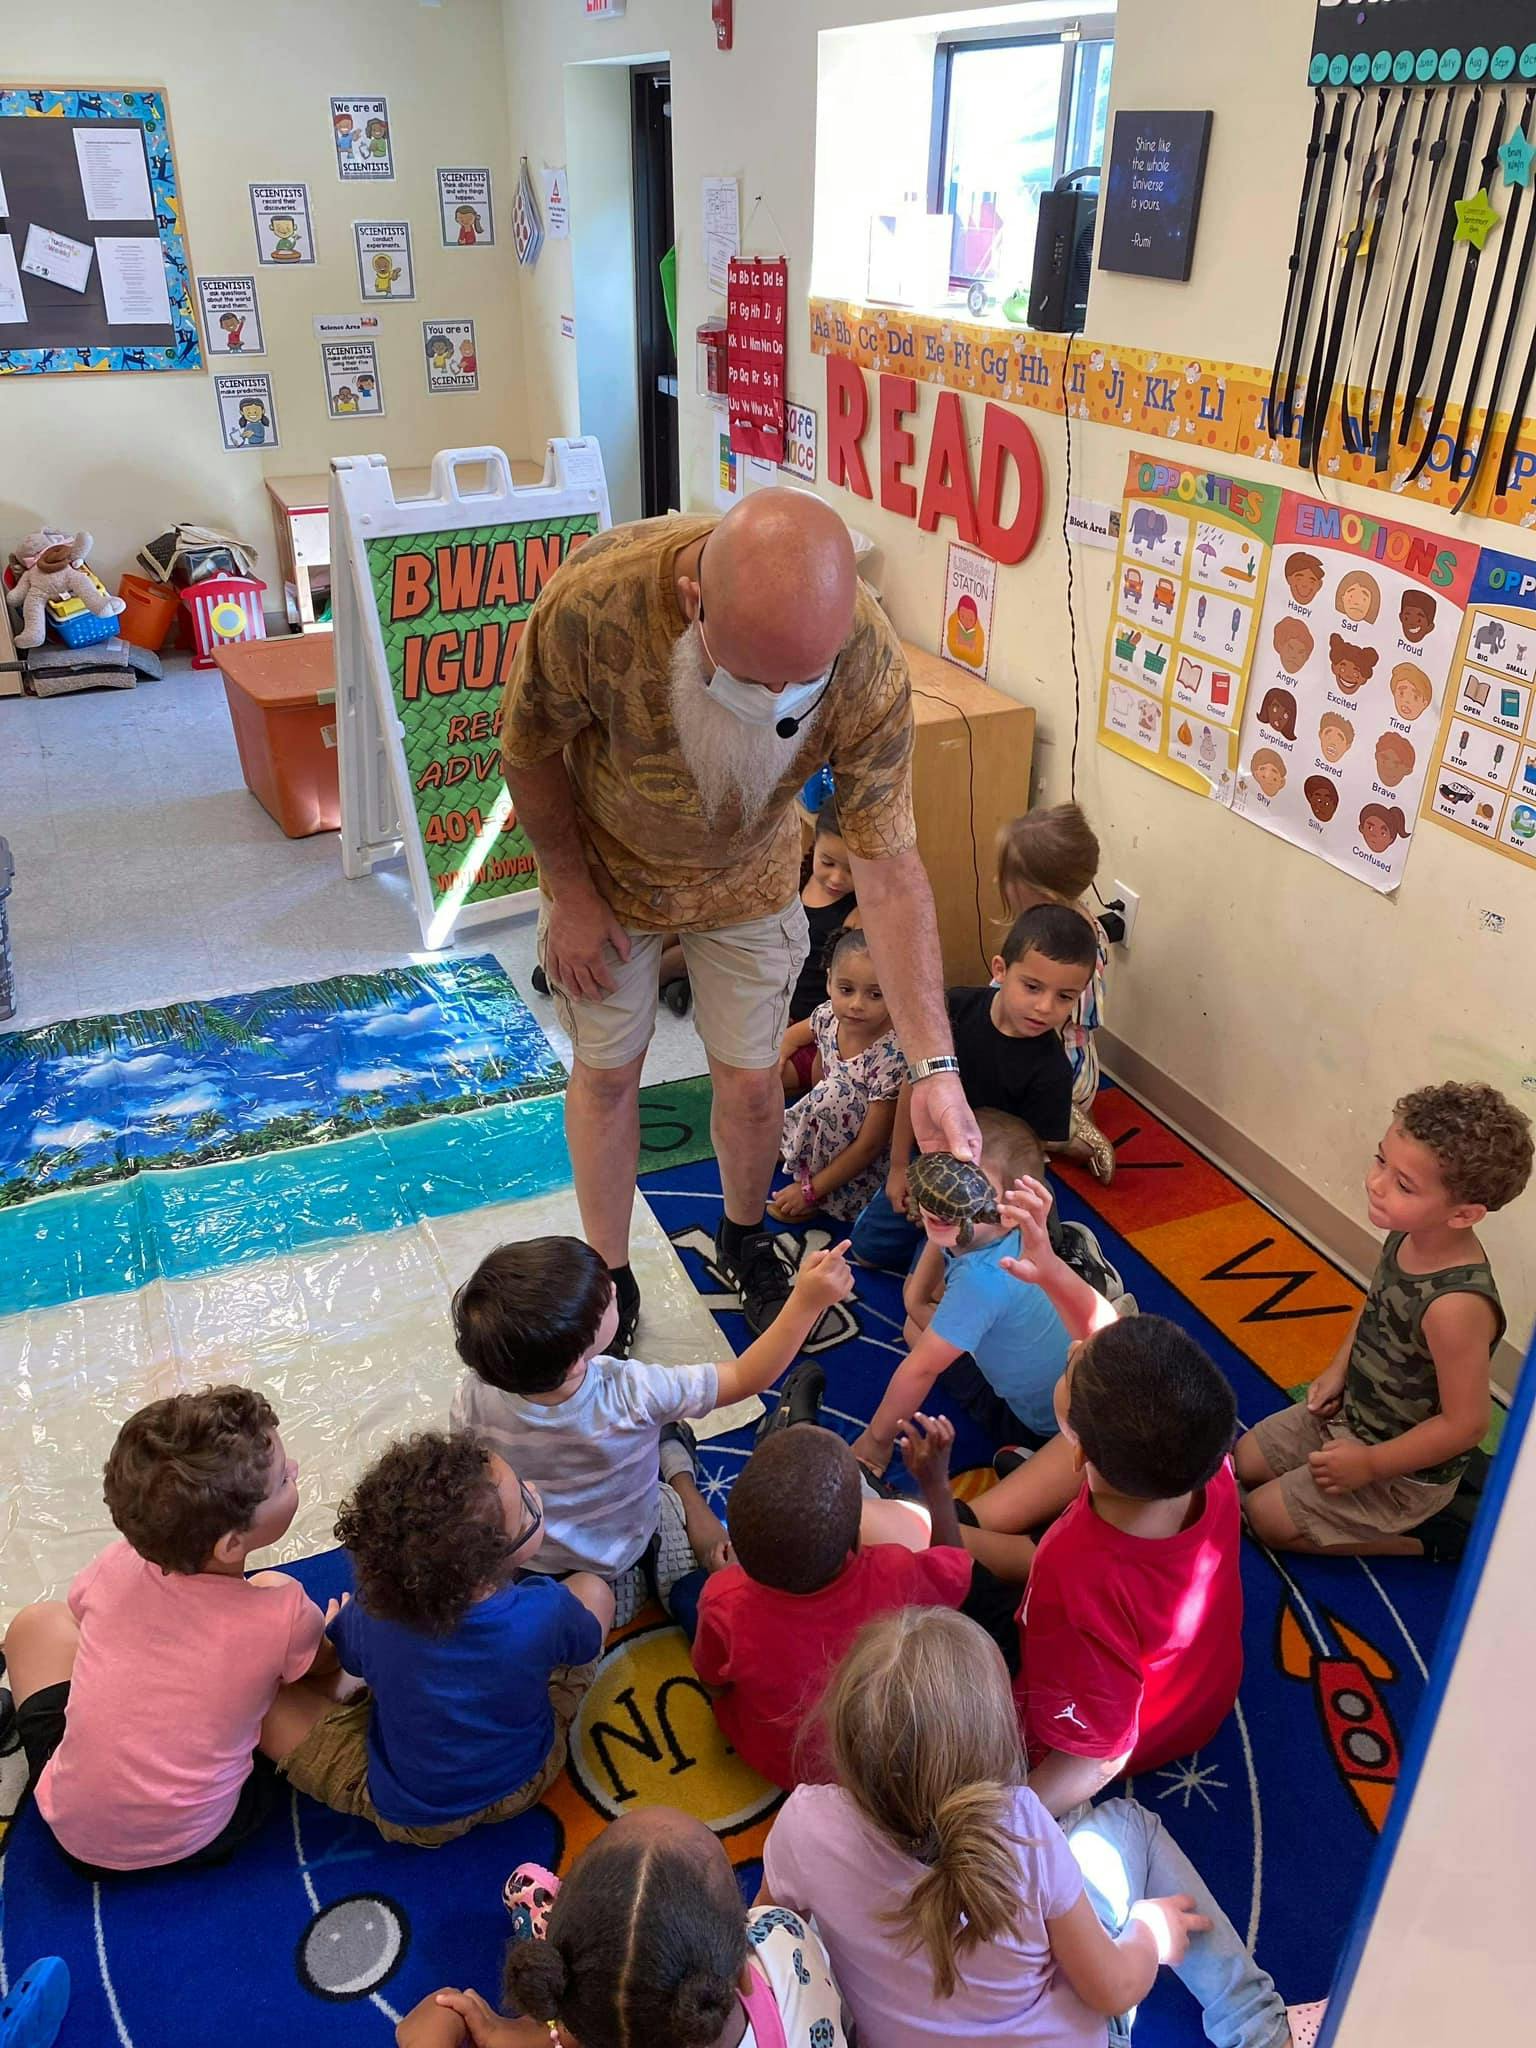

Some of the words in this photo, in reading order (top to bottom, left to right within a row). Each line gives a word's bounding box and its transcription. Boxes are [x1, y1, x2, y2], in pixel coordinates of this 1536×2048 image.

[335, 103, 350, 112] We
[353, 104, 369, 112] are
[373, 103, 383, 112] all
[1135, 136, 1156, 152] Shine
[1157, 137, 1171, 153] like
[343, 162, 389, 171] SCIENTISTS
[1132, 159, 1145, 172] the
[1146, 159, 1170, 172] whole
[441, 173, 486, 181] SCIENTISTS
[254, 189, 303, 198] SCIENTISTS
[1131, 199, 1137, 209] is
[1139, 198, 1161, 211] yours.
[360, 227, 404, 235] SCIENTISTS
[729, 270, 737, 284] Aa
[739, 270, 749, 284] Bb
[751, 271, 760, 286] Cc
[763, 272, 773, 286] Dd
[775, 272, 784, 287] Ee
[203, 282, 251, 290] SCIENTISTS
[730, 301, 737, 315] Ff
[740, 302, 749, 320] Gg
[751, 303, 760, 318] Hh
[764, 302, 771, 319] Ii
[775, 306, 782, 324] Jj
[428, 326, 443, 334] You
[326, 346, 371, 355] SCIENTISTS
[728, 333, 737, 347] Kk
[761, 338, 772, 353] Nn
[773, 339, 783, 354] Oo
[813, 314, 831, 339] Aa
[835, 319, 852, 346] Bb
[858, 326, 878, 352] Cc
[887, 331, 914, 358] Dd
[925, 335, 945, 363] Ee
[954, 342, 971, 370] Ff
[980, 347, 1008, 384] Gg
[1019, 355, 1049, 387] Hh
[1070, 363, 1086, 394] Ii
[1105, 368, 1125, 409] Jj
[1143, 376, 1177, 413] Kk
[1198, 386, 1225, 421] Ll
[432, 375, 474, 385] SCIENTIST
[728, 366, 738, 383] Pp
[740, 368, 749, 385] Qq
[752, 370, 759, 384] Rr
[763, 371, 771, 386] Ss
[220, 379, 266, 388] SCIENTISTS
[729, 397, 740, 411] Uu
[751, 401, 763, 416] Ww
[763, 403, 774, 417] Xx
[784, 405, 812, 440] afe
[781, 437, 814, 471] lace
[826, 353, 1044, 565] READ
[1138, 462, 1264, 524] OPPOSITES
[1069, 515, 1088, 529] Block
[1089, 521, 1107, 535] Area
[1295, 503, 1458, 587] EMOTIONS
[953, 555, 991, 580] LIBRARY
[1161, 556, 1175, 567] Small
[953, 572, 988, 600] STATION
[1228, 579, 1238, 589] Dry
[1489, 567, 1536, 596] OPP
[1287, 600, 1312, 618] Happy
[1151, 615, 1164, 625] Back
[1341, 619, 1358, 632] Sad
[1193, 631, 1206, 642] Stop
[1224, 643, 1233, 653] Go
[1397, 639, 1423, 657] Proud
[1477, 653, 1488, 662] BIG
[1505, 663, 1528, 676] SMALL
[1142, 673, 1157, 687] Empty
[1276, 671, 1298, 687] Angry
[1177, 691, 1192, 703] Open
[1327, 691, 1358, 711] Excited
[1206, 704, 1225, 718] Closed
[1463, 704, 1481, 717] OPEN
[1112, 717, 1126, 729] Clean
[1389, 716, 1411, 734] Tired
[1492, 716, 1519, 731] CLOSED
[1138, 730, 1152, 742] Dirty
[1259, 729, 1294, 752] Surprised
[1176, 751, 1187, 760] Hot
[1450, 755, 1468, 767] STOP
[416, 749, 505, 790] ADV
[1197, 759, 1211, 771] Cold
[1314, 758, 1343, 778] Scared
[1487, 771, 1498, 780] GO
[1371, 782, 1397, 800] Brave
[1256, 792, 1271, 807] Shy
[1440, 804, 1456, 816] FAST
[1308, 818, 1325, 834] Silly
[1470, 818, 1490, 832] SLOW
[1510, 836, 1525, 848] DAY
[1352, 846, 1392, 873] Confused
